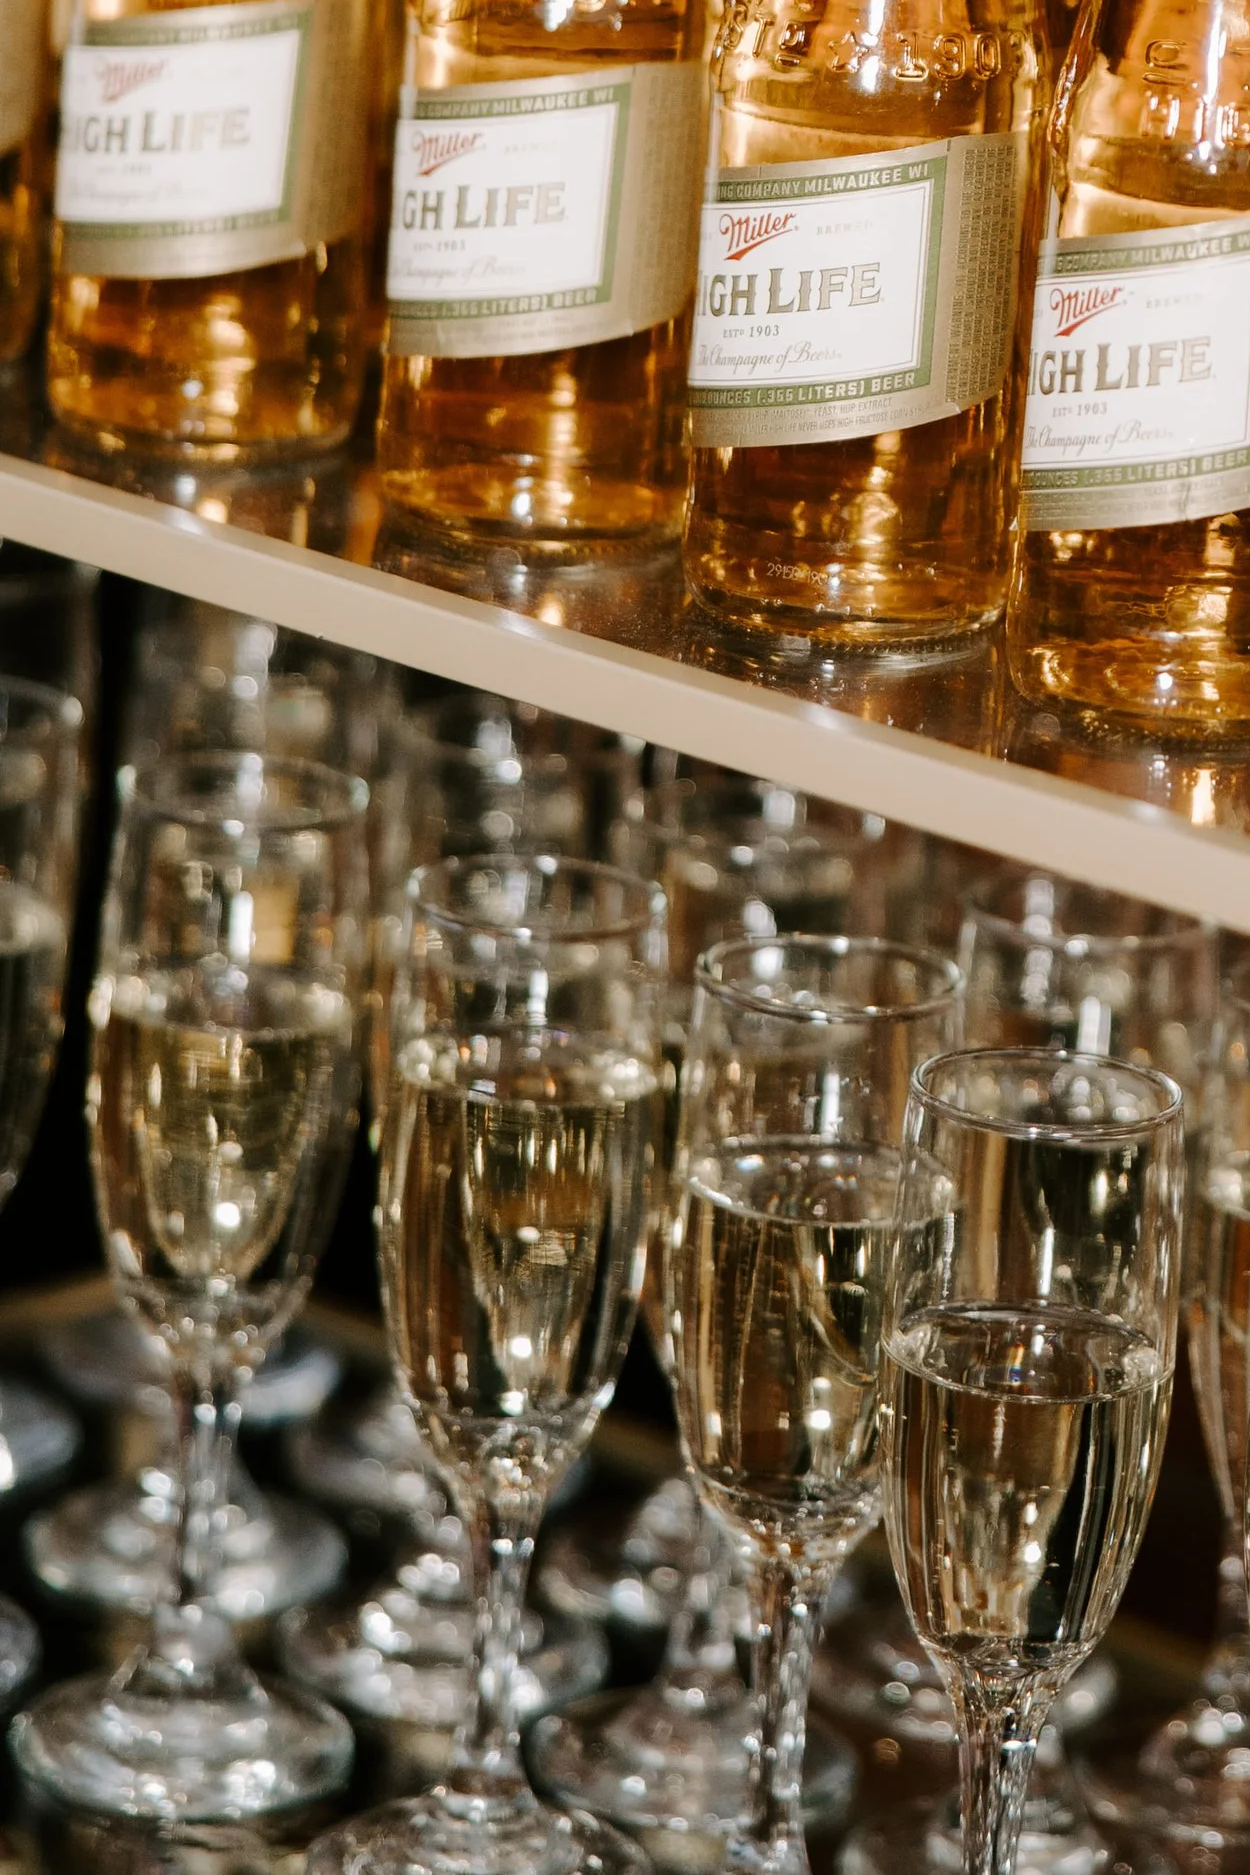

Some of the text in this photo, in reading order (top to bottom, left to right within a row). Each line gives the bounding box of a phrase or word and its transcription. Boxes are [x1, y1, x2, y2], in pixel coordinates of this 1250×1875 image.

[493, 89, 588, 113] MILWAUKEE
[593, 86, 614, 103] WI
[141, 107, 251, 153] LIFE
[412, 131, 483, 175] Miller
[736, 180, 801, 198] COMPANY
[804, 169, 902, 193] MILWAUKEE
[909, 163, 929, 179] WI
[402, 181, 566, 231] GH LIFE
[720, 212, 798, 259] Miller
[1131, 239, 1231, 264] MILWAUKEE
[553, 288, 597, 308] BEER
[698, 262, 882, 317] IGH LIFE
[1050, 286, 1125, 334] Miller
[749, 325, 780, 338] 1903
[708, 346, 775, 374] Champagne
[776, 350, 794, 372] of
[1094, 336, 1213, 392] LIFE
[798, 379, 865, 402] LITERS)
[871, 372, 915, 394] BEER
[838, 416, 854, 428] HIGH
[1076, 402, 1108, 418] 1903
[1037, 424, 1102, 456] Champagne
[1104, 425, 1124, 451] of
[1202, 450, 1247, 471] BEER
